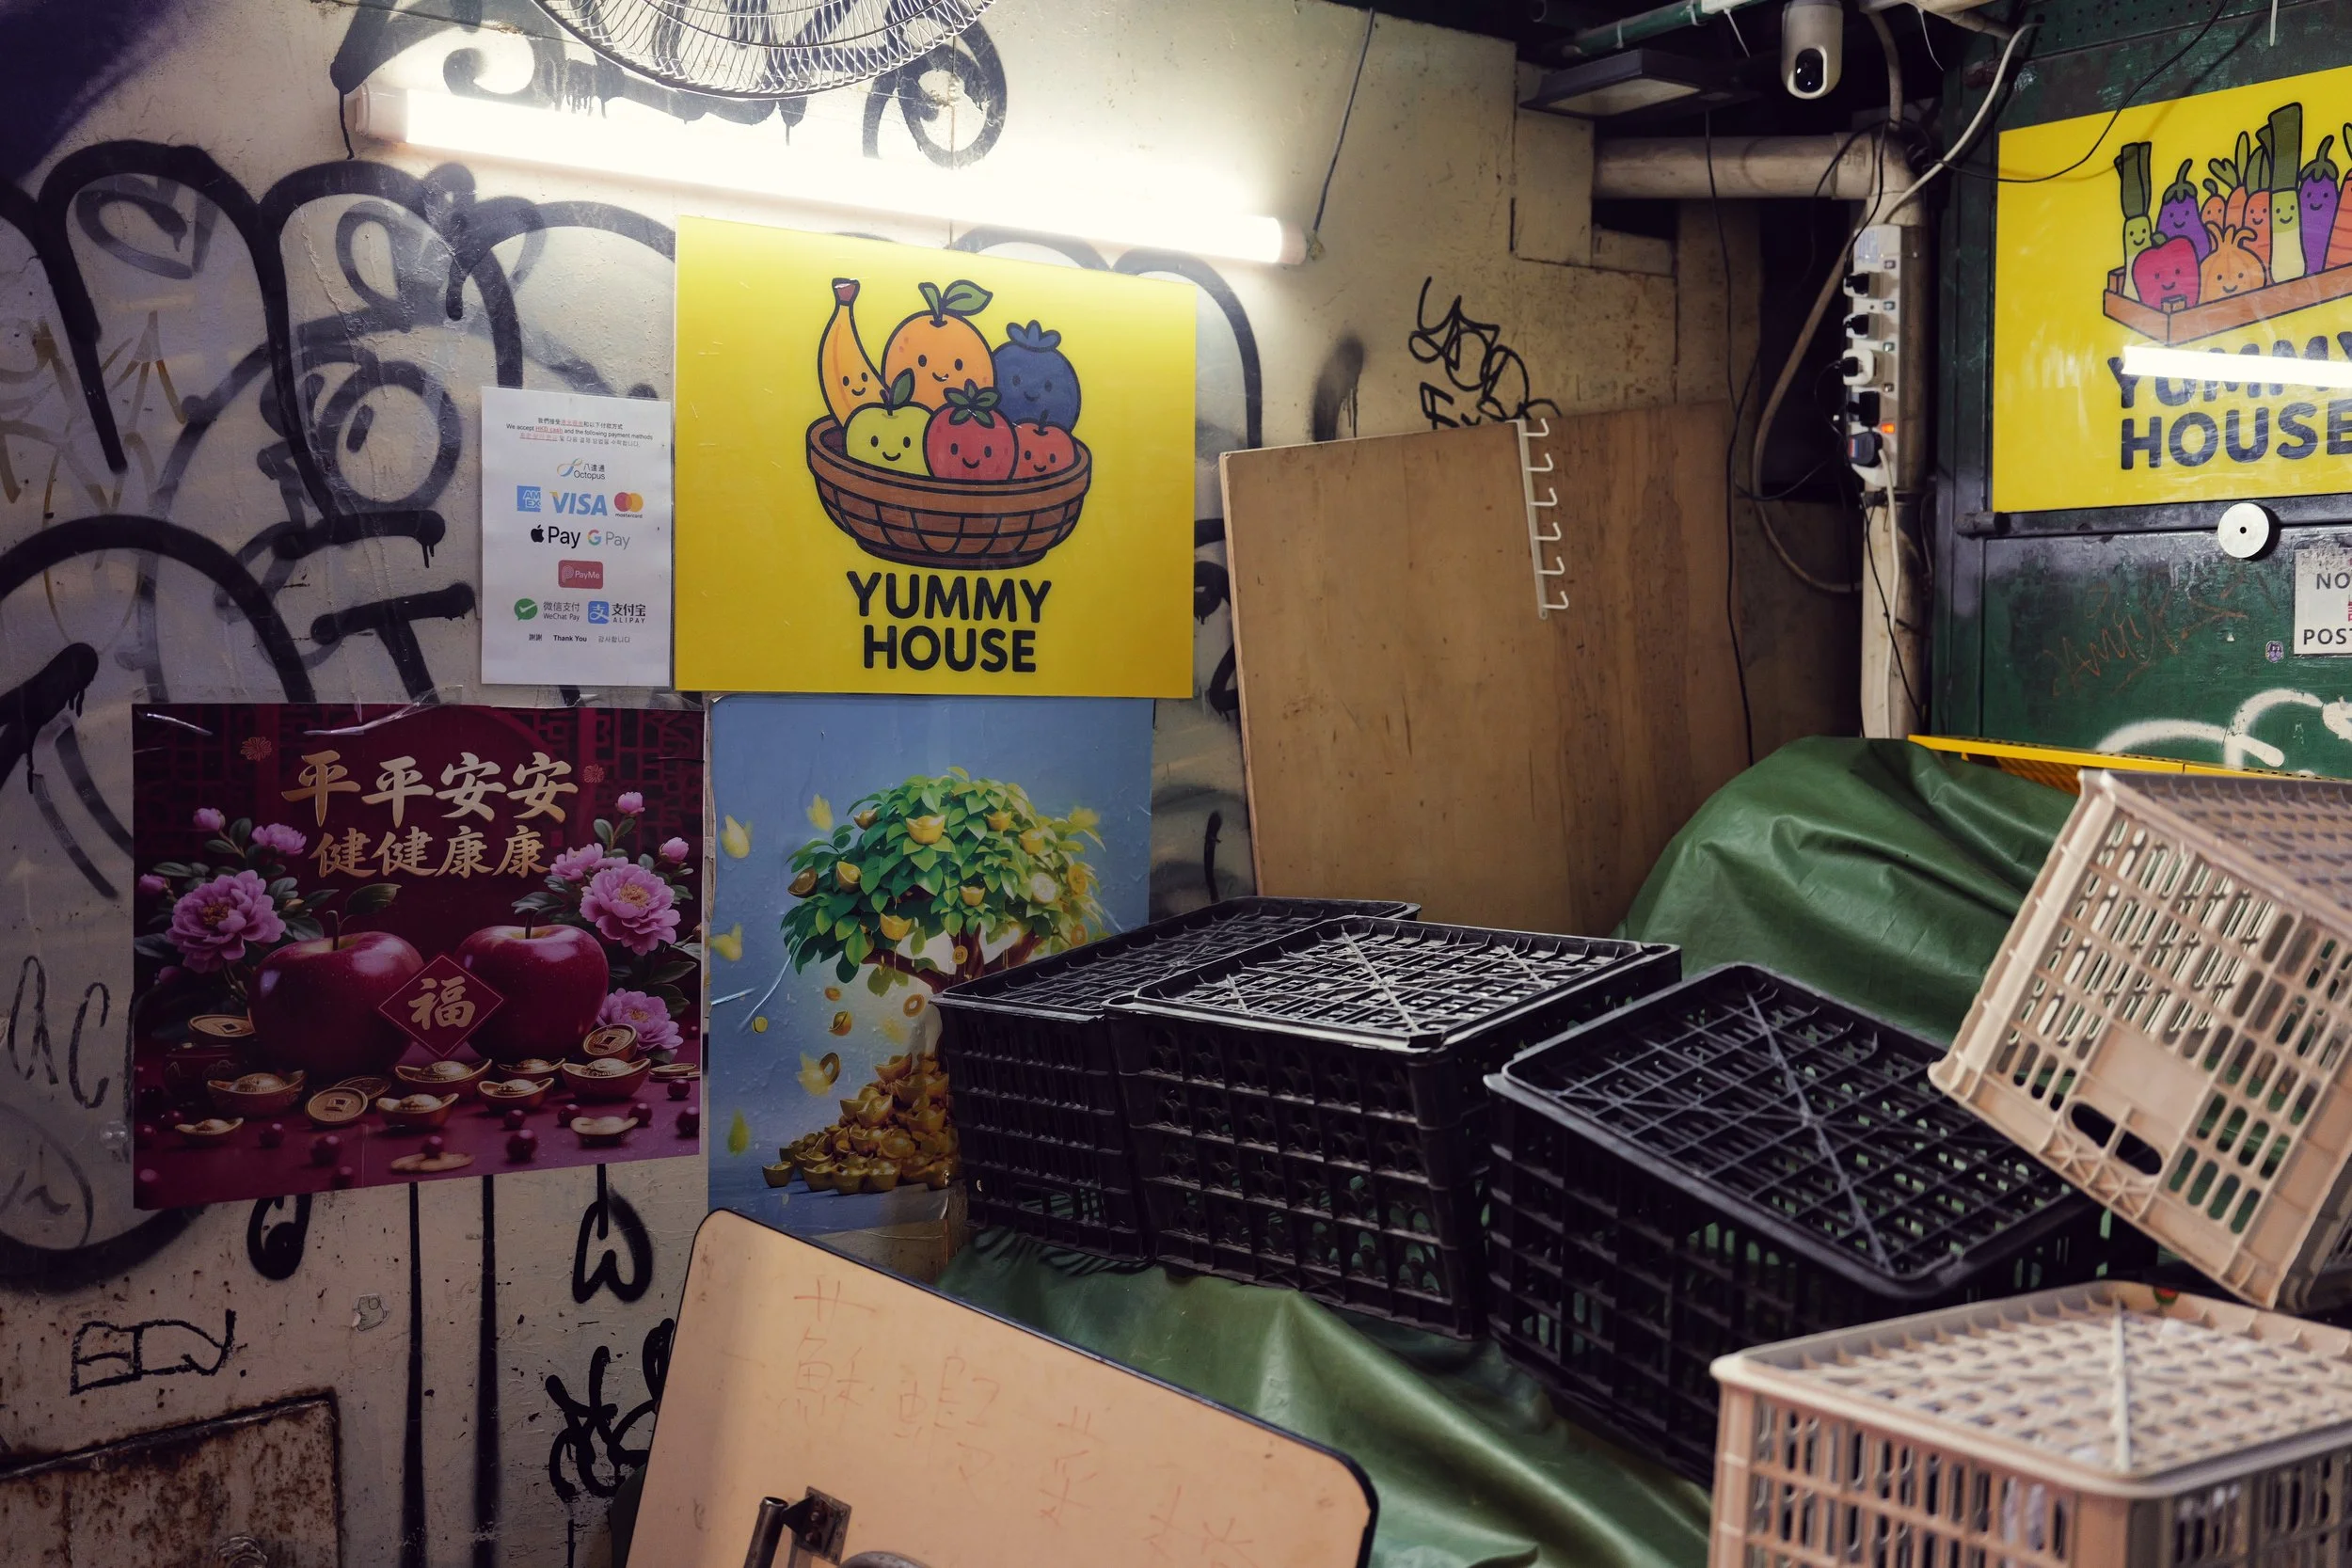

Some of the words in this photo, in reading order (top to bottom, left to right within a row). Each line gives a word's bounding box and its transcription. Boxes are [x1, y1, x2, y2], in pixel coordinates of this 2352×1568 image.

[2107, 332, 2352, 409] YUMM
[584, 429, 607, 437] following
[2121, 399, 2352, 470] HOUSE
[573, 470, 606, 481] Octopus
[583, 463, 605, 472] 八達通
[549, 491, 608, 516] VISA
[548, 526, 580, 548] Pay
[605, 531, 630, 550] Pay
[575, 570, 600, 579] PayMe
[543, 601, 580, 611] 微信支付
[847, 571, 1052, 623] YUMMY
[612, 603, 646, 617] 支付宝
[2303, 628, 2352, 645] POS
[864, 625, 1036, 673] HOUSE
[281, 750, 578, 828] 平平安安
[309, 825, 550, 879] 健健康康
[408, 975, 475, 1030] 福
